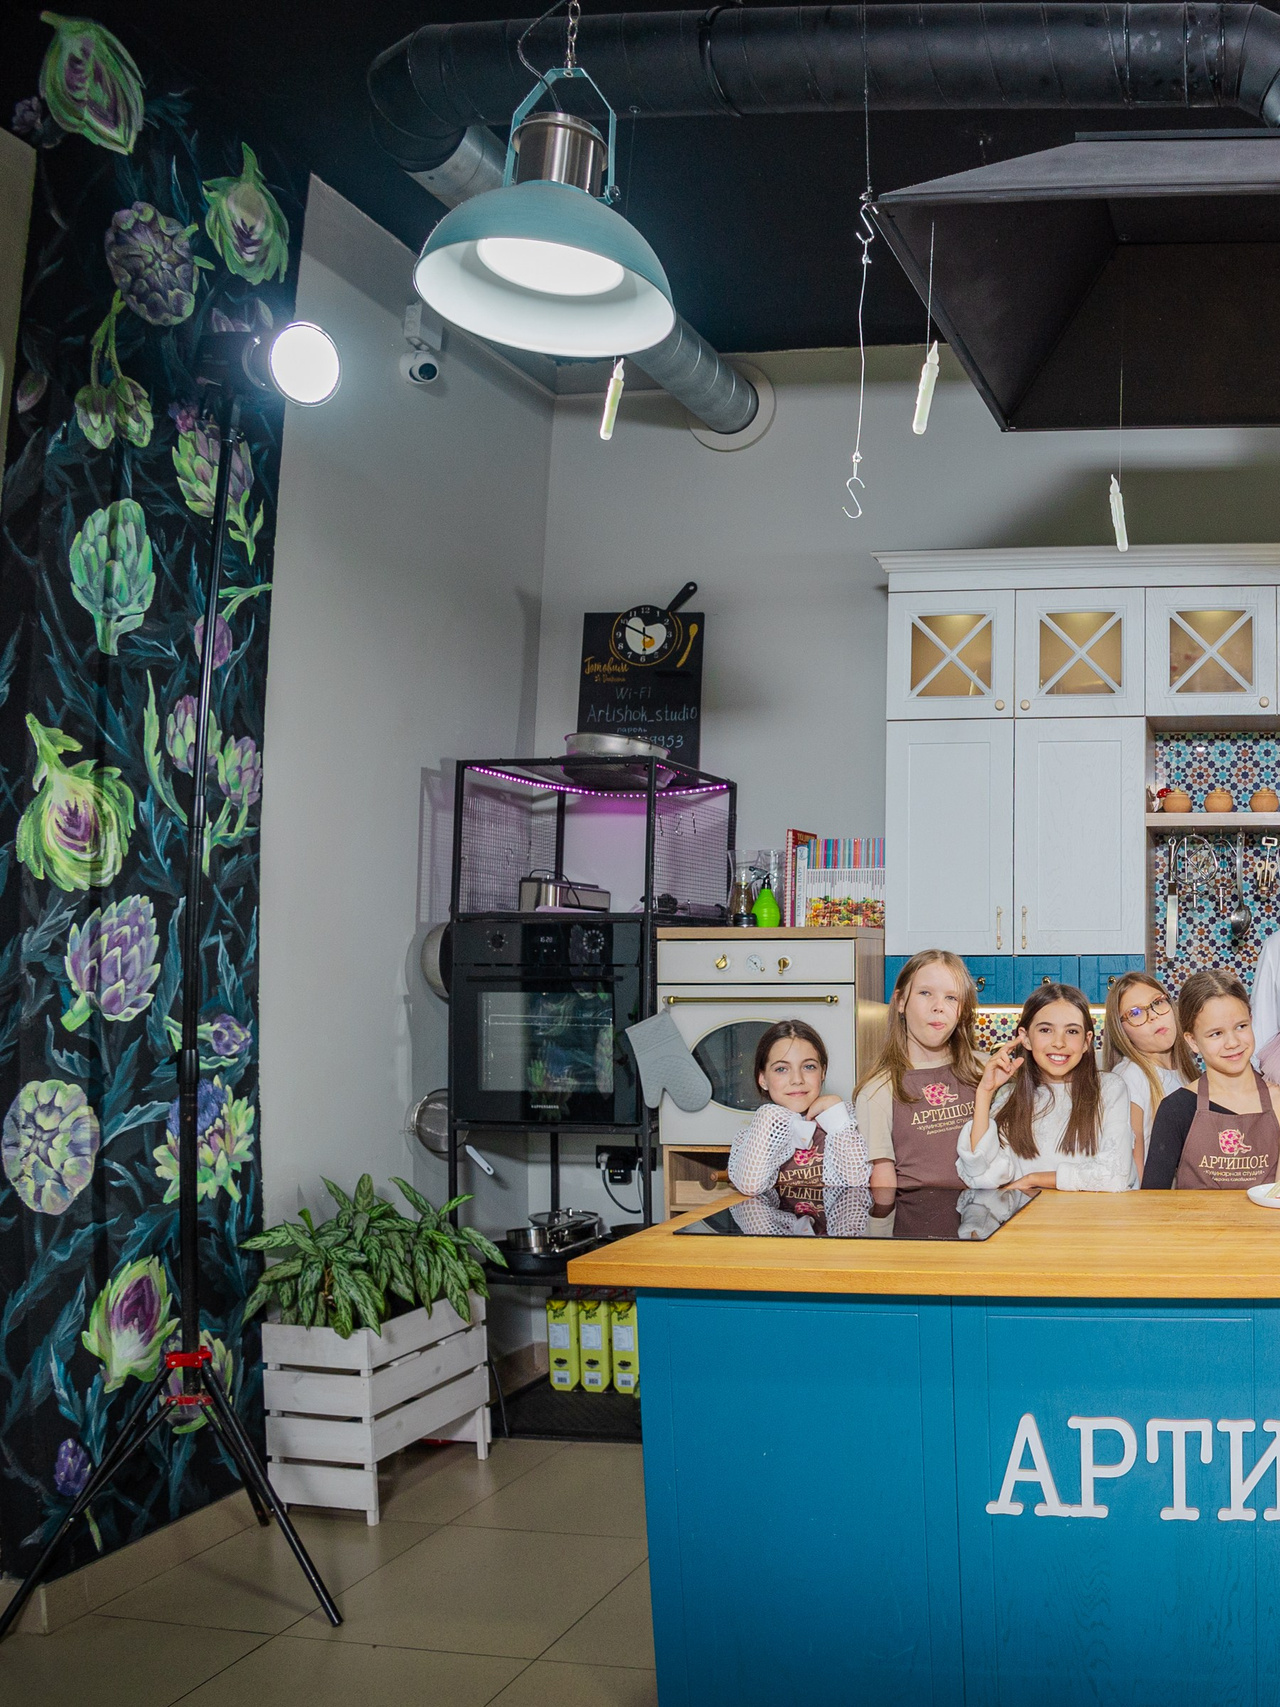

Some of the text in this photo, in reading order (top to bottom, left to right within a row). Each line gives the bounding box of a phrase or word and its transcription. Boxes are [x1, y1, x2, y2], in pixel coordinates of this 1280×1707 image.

[616, 726, 648, 734] пароль
[911, 1101, 976, 1125] АРТИШОК
[1198, 1154, 1269, 1170] АРТИШОК
[778, 1165, 823, 1182] АРТИШ
